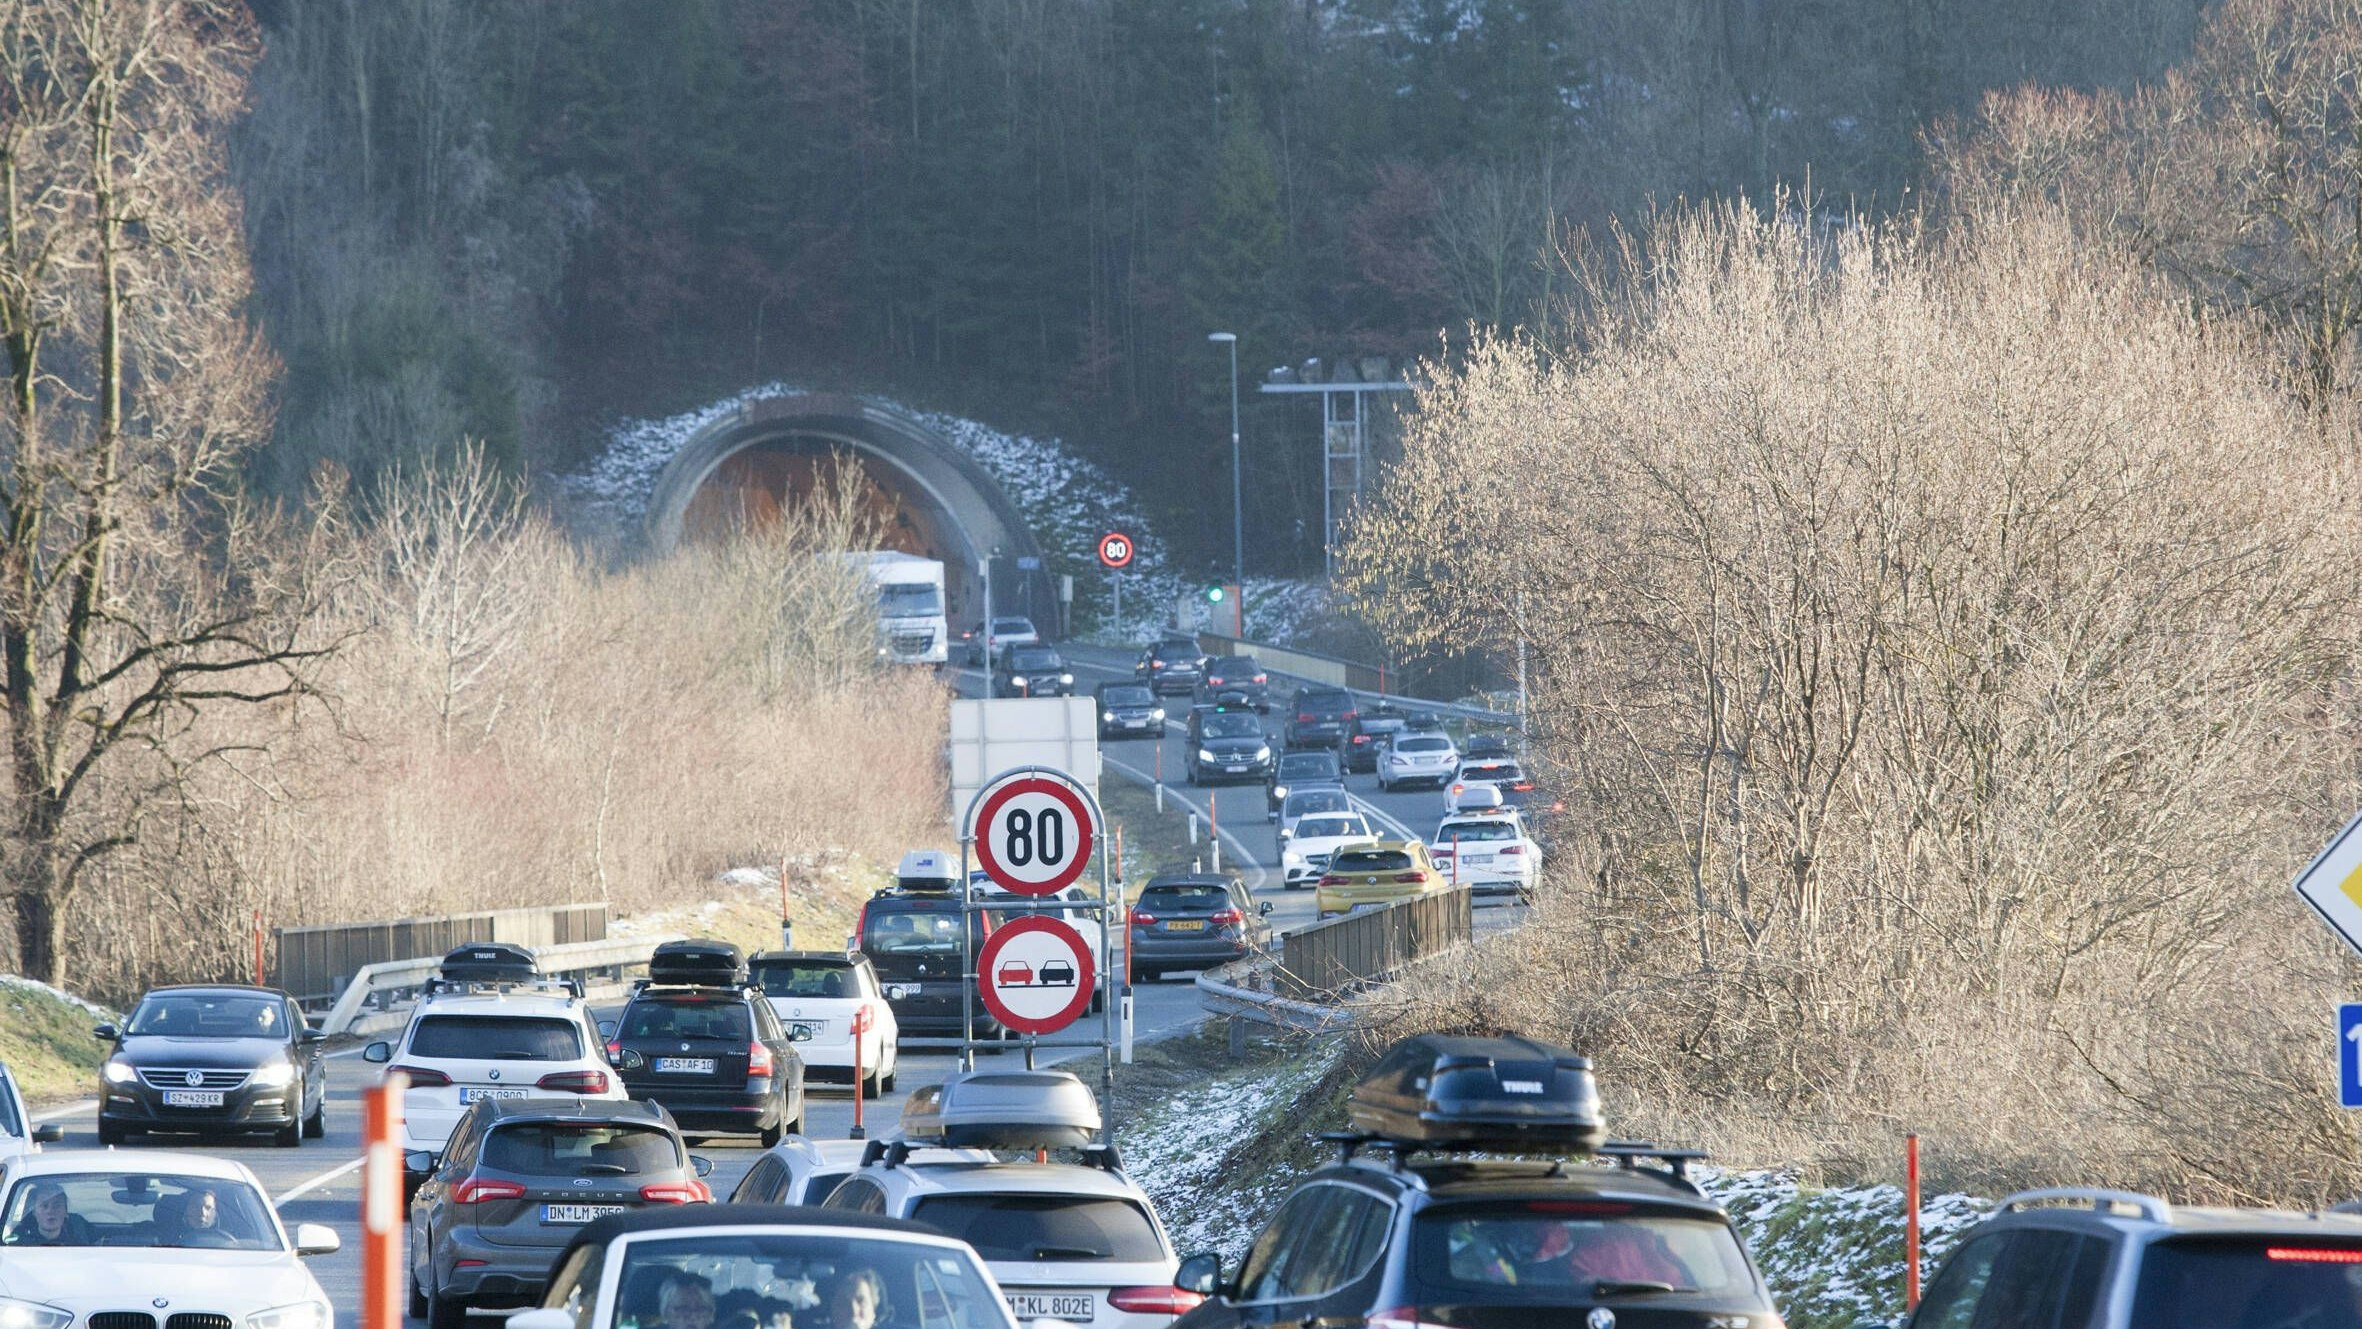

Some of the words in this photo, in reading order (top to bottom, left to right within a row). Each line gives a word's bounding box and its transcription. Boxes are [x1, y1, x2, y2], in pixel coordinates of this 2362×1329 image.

[1106, 541, 1127, 558] 80
[1006, 808, 1063, 867] 80
[662, 1060, 681, 1069] CAS
[687, 1061, 699, 1070] AF
[549, 1206, 565, 1220] DN
[574, 1206, 590, 1220] LM
[1027, 1297, 1048, 1314] KL
[1052, 1298, 1091, 1315] 802E
